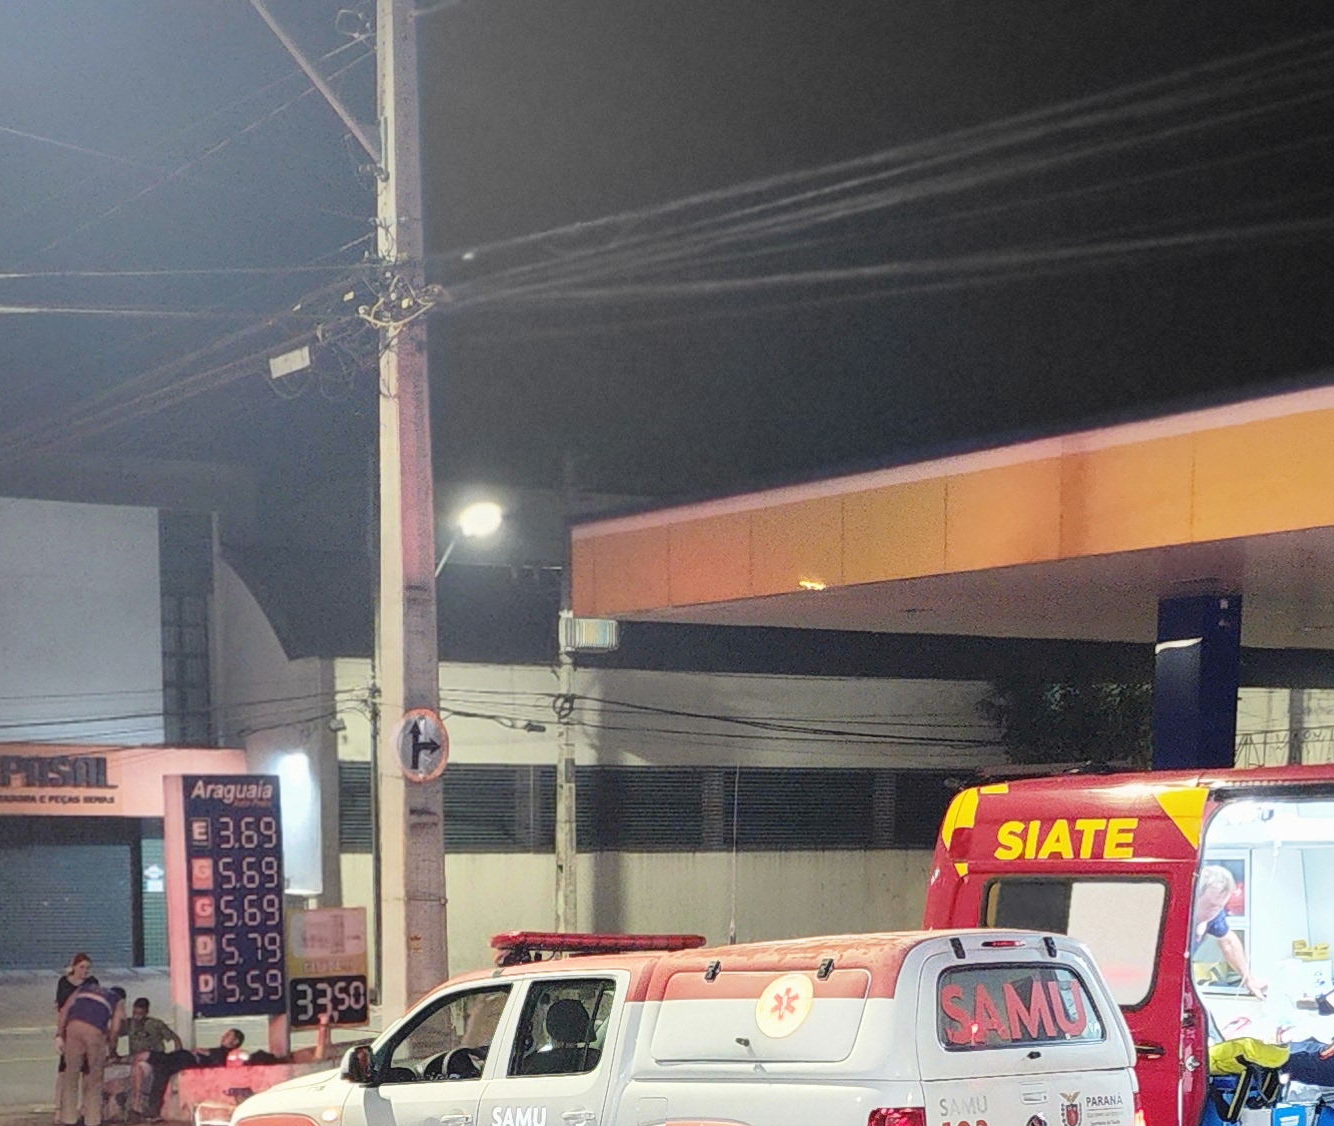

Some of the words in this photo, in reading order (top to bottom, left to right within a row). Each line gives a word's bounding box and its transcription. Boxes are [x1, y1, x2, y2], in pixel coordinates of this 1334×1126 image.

[191, 779, 273, 804] Araguaia
[192, 821, 208, 840] E
[219, 816, 277, 849] 3,69
[994, 818, 1139, 861] SIATE
[218, 856, 278, 889] 5,69
[195, 899, 213, 917] G
[219, 894, 280, 927] 5,69
[221, 932, 281, 965] 5,79
[198, 974, 214, 993] D
[223, 969, 282, 1003] 5,59
[295, 981, 366, 1023] 33,50
[940, 979, 1088, 1045] SAMU
[940, 1095, 988, 1117] SAMU
[1086, 1092, 1124, 1107] PARANÁ
